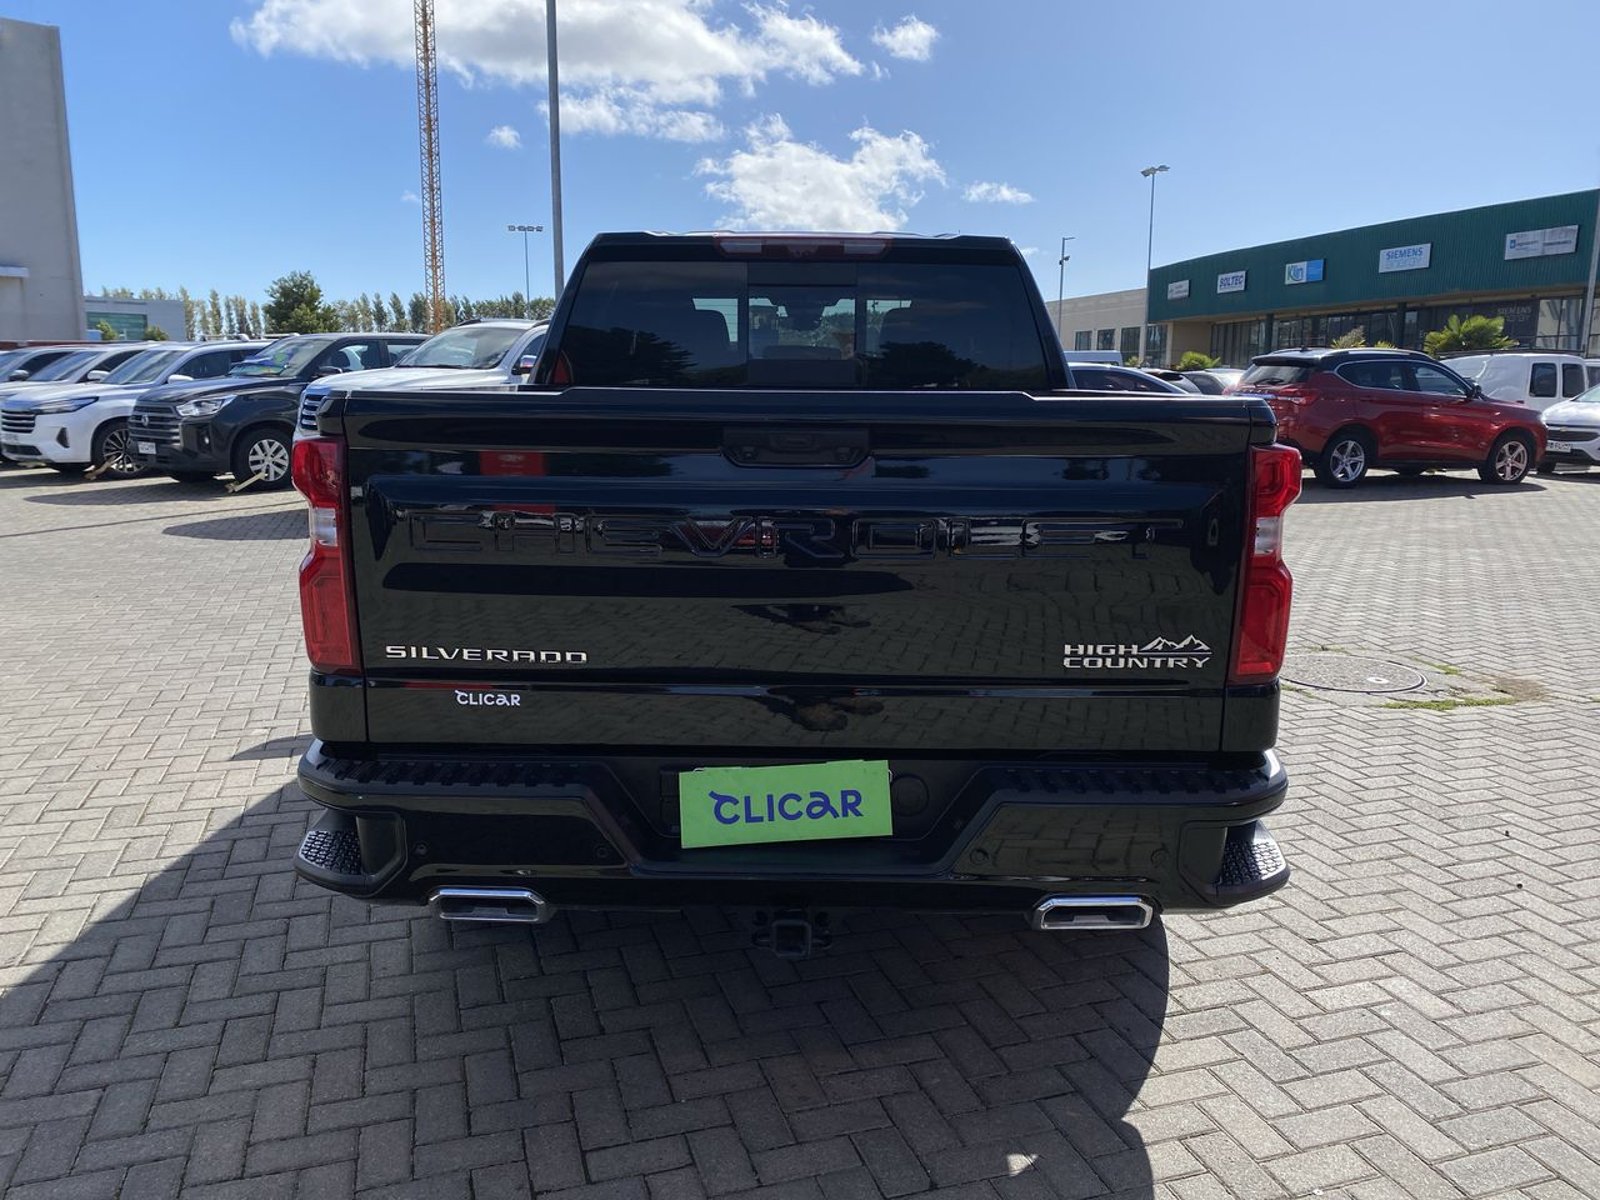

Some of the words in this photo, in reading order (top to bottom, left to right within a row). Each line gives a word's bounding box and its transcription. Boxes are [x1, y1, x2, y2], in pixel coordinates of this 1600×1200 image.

[1386, 247, 1423, 261] SIEMENS
[1219, 274, 1244, 288] SOLTEC
[385, 645, 588, 664] SILVERADO
[1064, 644, 1138, 655] HIGH
[1063, 656, 1210, 669] COUNTRY
